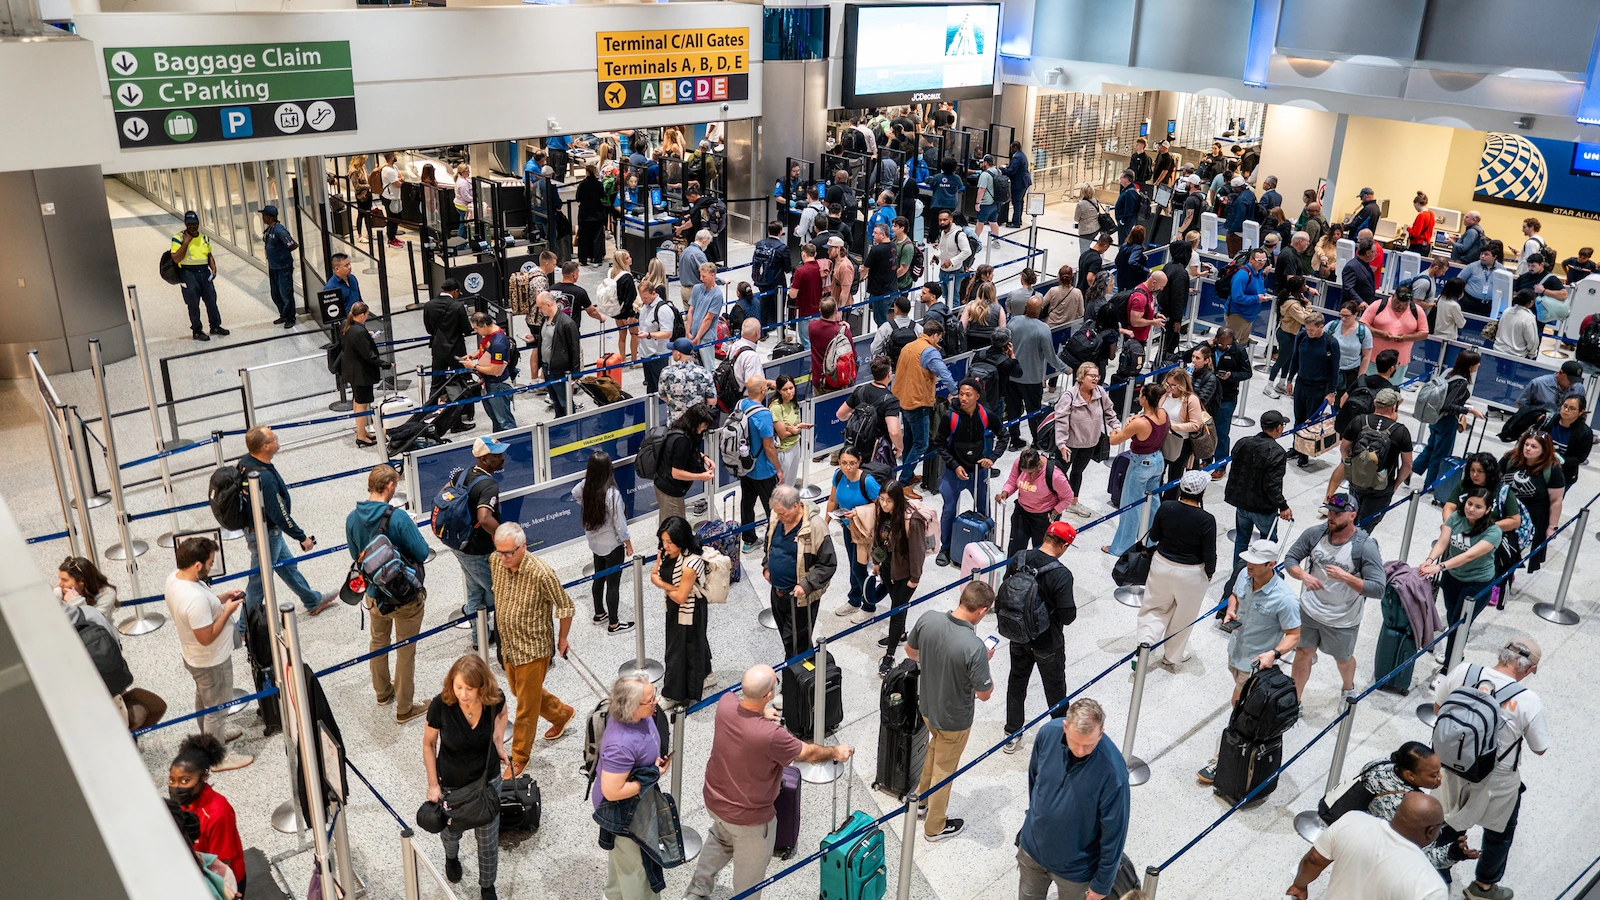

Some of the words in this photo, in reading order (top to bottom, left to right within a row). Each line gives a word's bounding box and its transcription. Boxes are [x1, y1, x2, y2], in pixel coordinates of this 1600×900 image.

[603, 34, 667, 52] Terminal
[671, 33, 703, 50] C/All
[706, 33, 744, 48] Gates
[153, 51, 256, 76] Baggage
[262, 47, 322, 67] Claim
[604, 58, 677, 76] Terminals
[681, 58, 696, 73] A,
[700, 57, 713, 73] B,
[717, 56, 731, 72] D,
[735, 55, 742, 69] E
[158, 80, 270, 103] C-Parking
[643, 83, 657, 100] A
[662, 82, 674, 99] B
[679, 80, 692, 98] C
[696, 79, 709, 96] D
[714, 78, 726, 95] E
[911, 92, 941, 102] JCDecaux
[228, 111, 246, 133] P
[1552, 208, 1575, 216] STAR
[582, 436, 603, 446] Welcome
[1018, 480, 1038, 492] nike
[532, 516, 546, 526] More
[546, 508, 572, 521] Exploring
